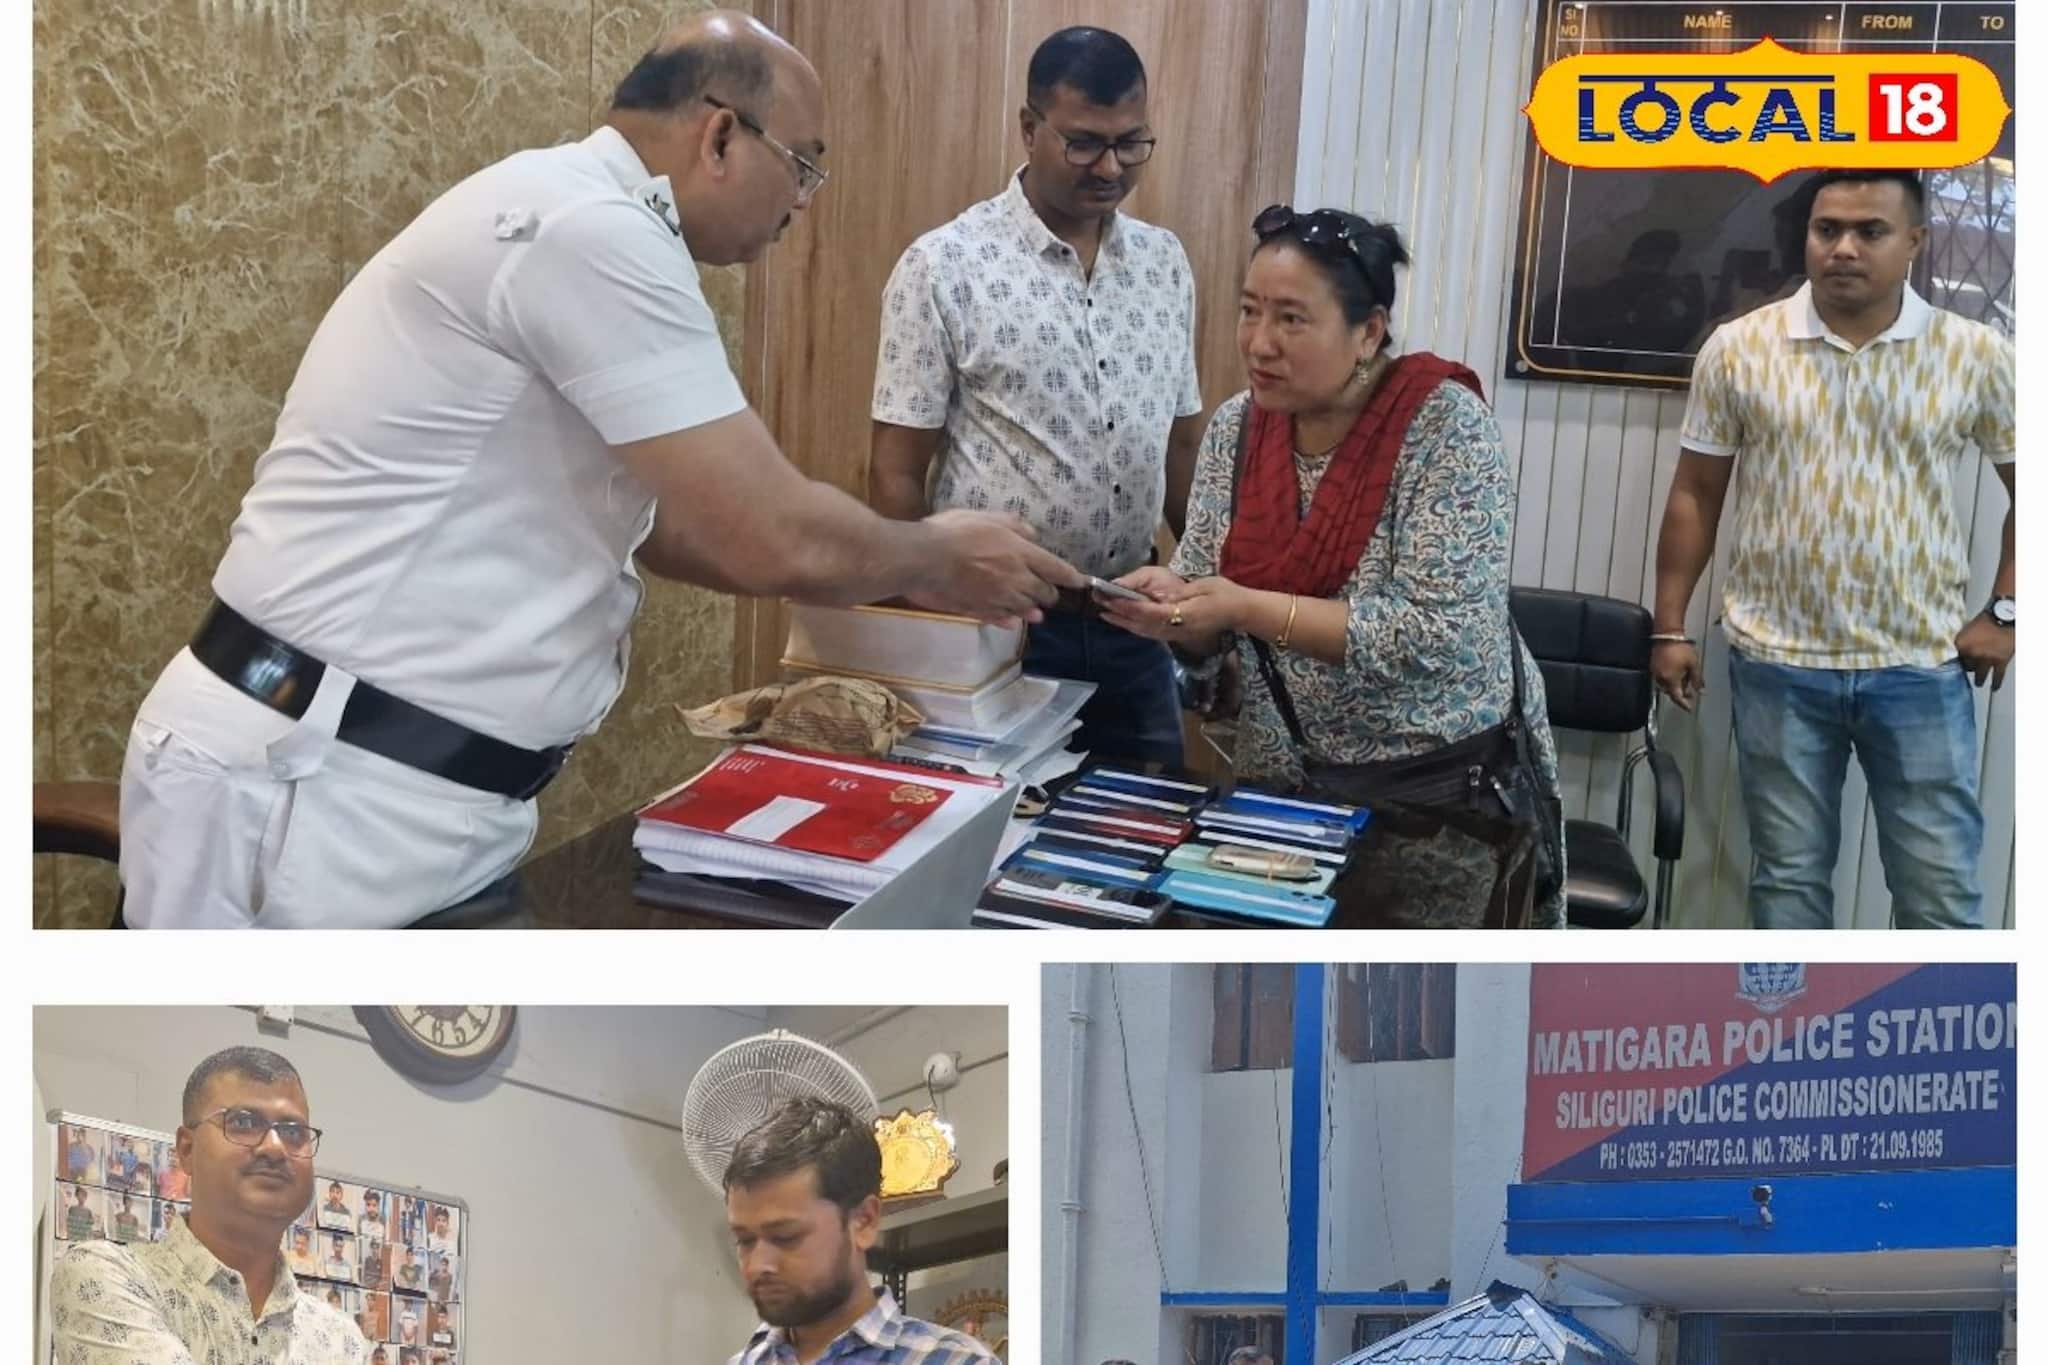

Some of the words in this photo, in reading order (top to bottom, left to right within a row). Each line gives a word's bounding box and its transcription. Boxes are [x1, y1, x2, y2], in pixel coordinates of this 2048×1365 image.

[1683, 14, 1732, 29] NAME
[1861, 15, 1913, 30] FROM
[1980, 16, 2005, 30] TO
[1534, 1023, 1711, 1075] MATIGARA
[1723, 1013, 1854, 1066] POLICE
[1556, 1088, 1655, 1128] SILIGURI
[1664, 1083, 1747, 1125] POLICE
[1754, 1069, 2000, 1121] COMMISSIONERATE
[1600, 1143, 1617, 1169] PH
[1628, 1142, 1656, 1168] 0353
[1667, 1139, 1719, 1168] 2571472
[1752, 1136, 1775, 1164] NO.
[1779, 1134, 1810, 1163] 7364
[1821, 1134, 1837, 1162] PL
[1841, 1132, 1859, 1160] DT
[1870, 1129, 1943, 1159] 21.09.1985
